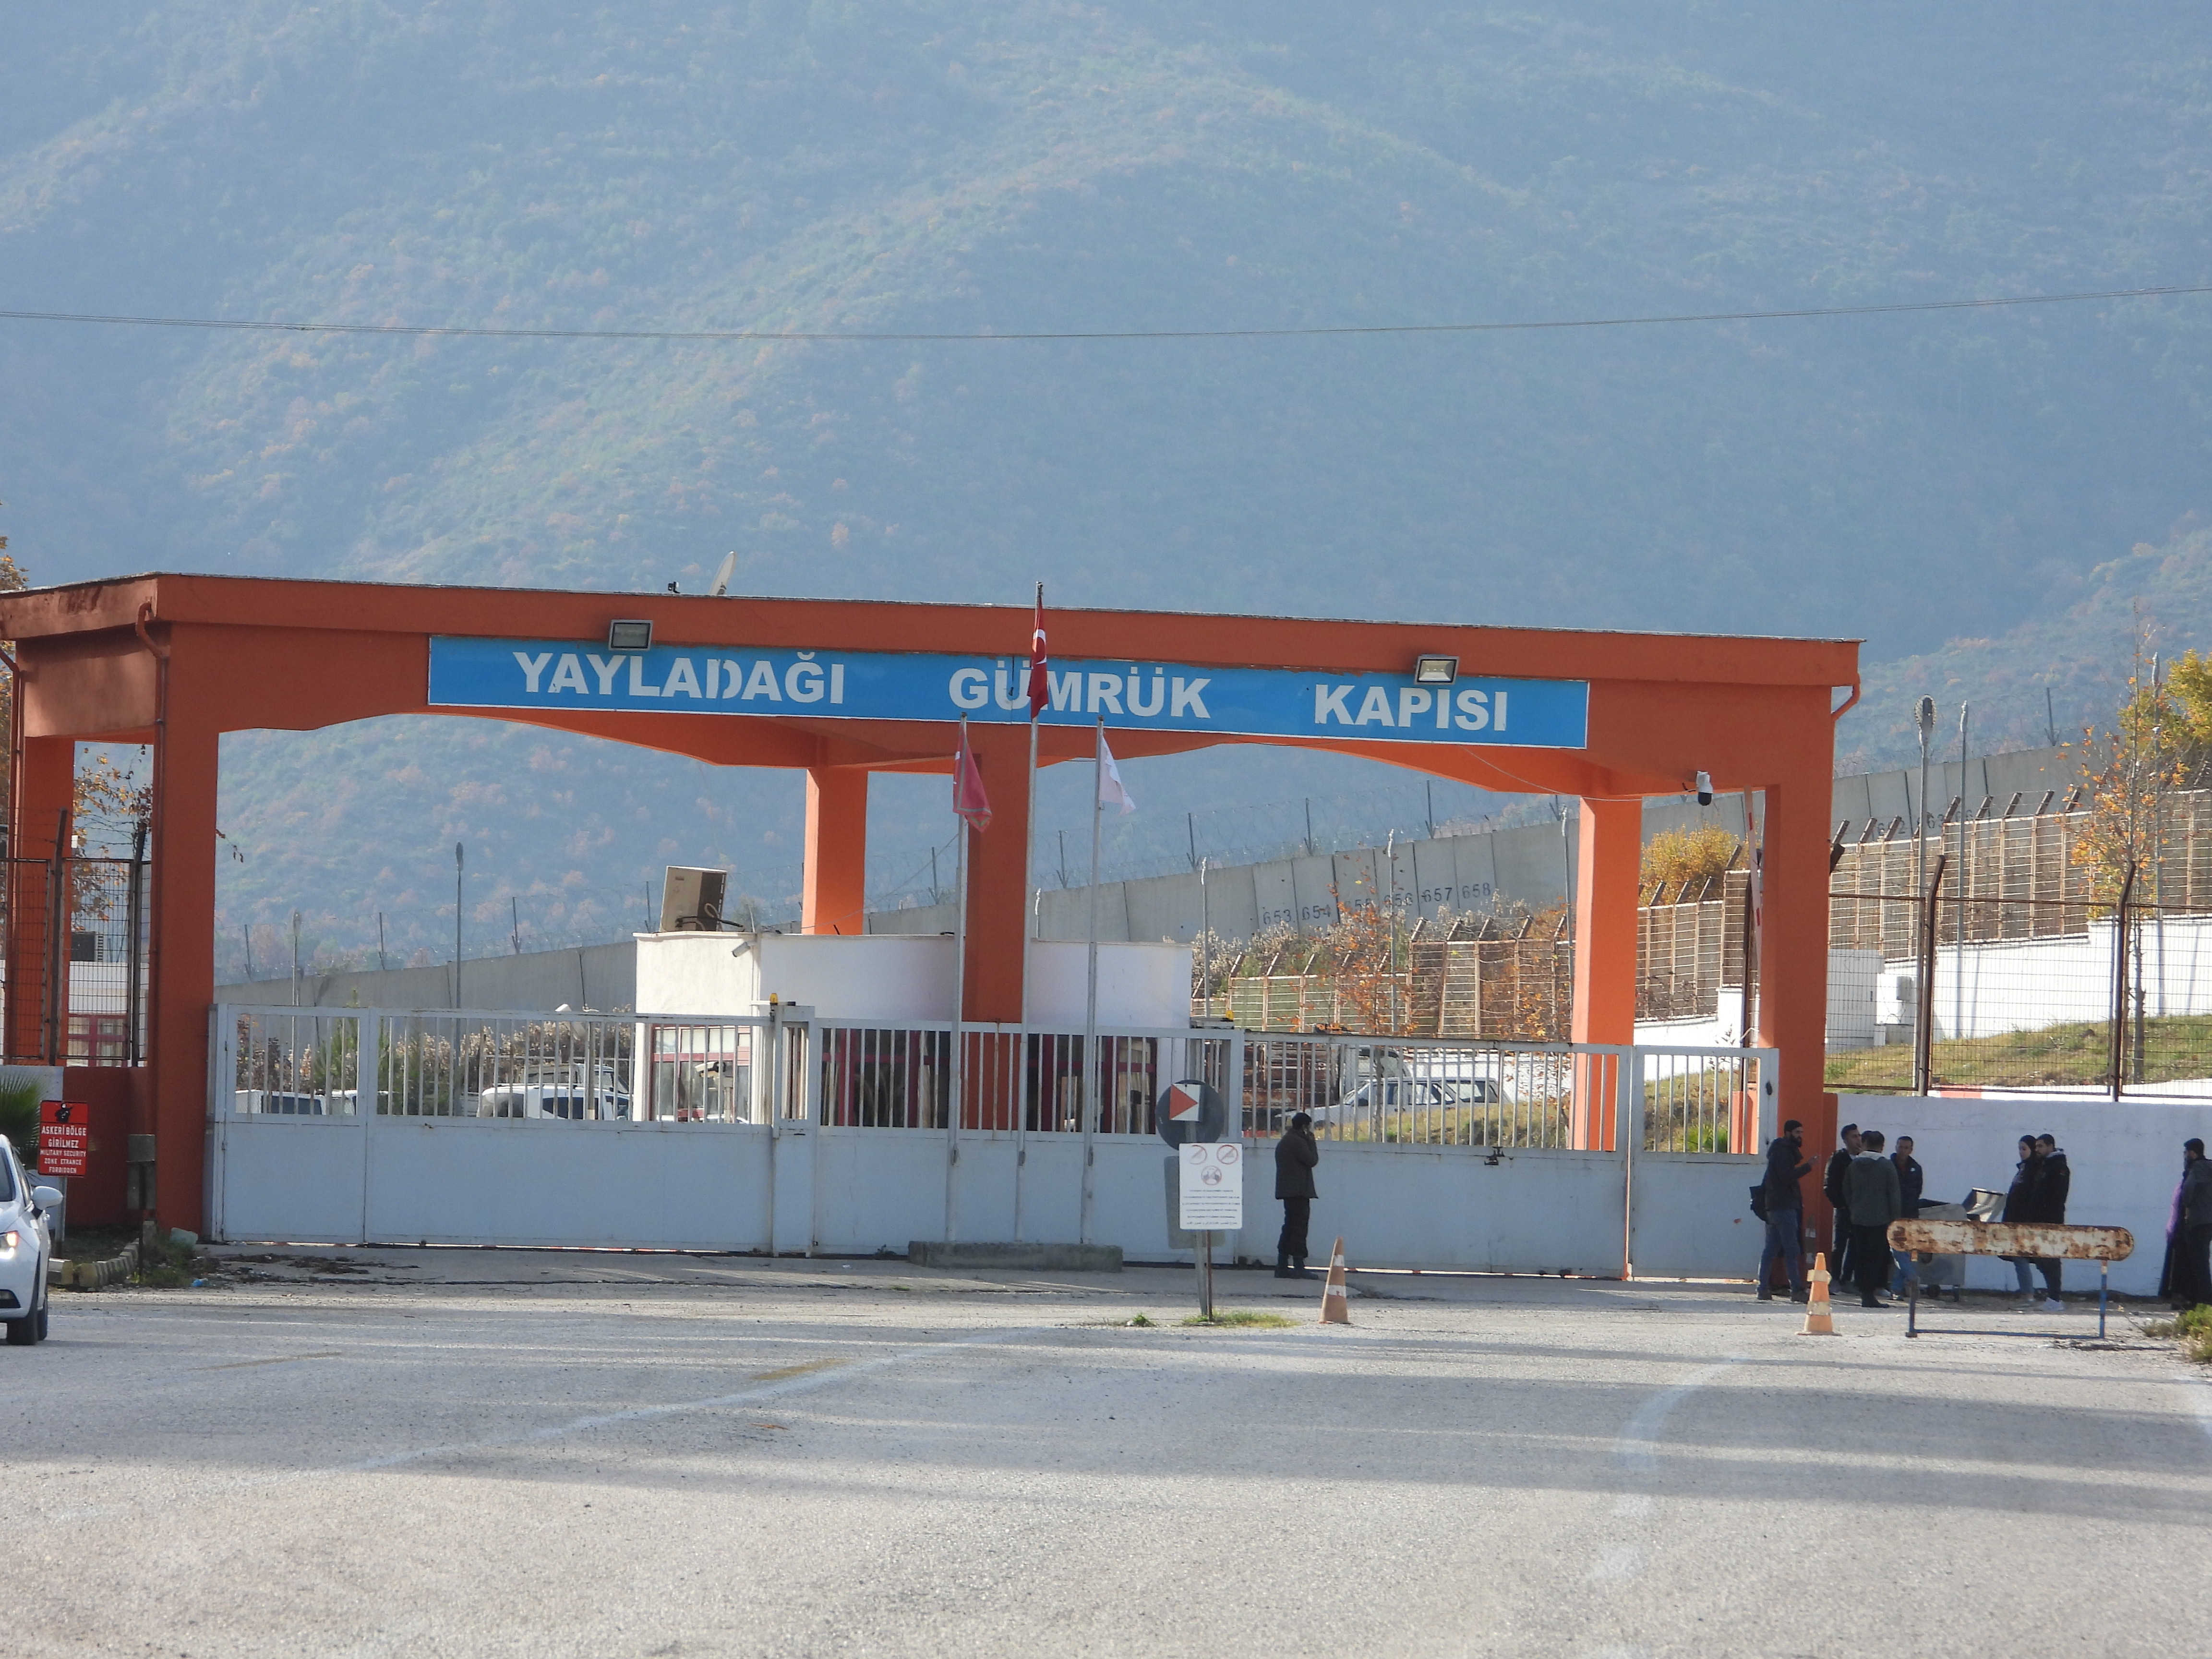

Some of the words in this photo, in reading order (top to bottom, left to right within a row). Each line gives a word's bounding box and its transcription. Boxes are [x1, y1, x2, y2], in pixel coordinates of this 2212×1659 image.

[513, 651, 845, 704] YAYLADAĞI
[949, 660, 1211, 719] GÜMRÜK
[1314, 684, 1508, 732] KAPISI
[1877, 819, 1905, 835] 62
[1423, 887, 1453, 903] 657
[1462, 882, 1491, 899] 658
[1262, 909, 1292, 925] 653
[1301, 904, 1331, 921] 654
[41, 1125, 65, 1134] ASKERİ
[66, 1125, 86, 1136] BÖLGE
[48, 1137, 79, 1148] GİRİLMEZ
